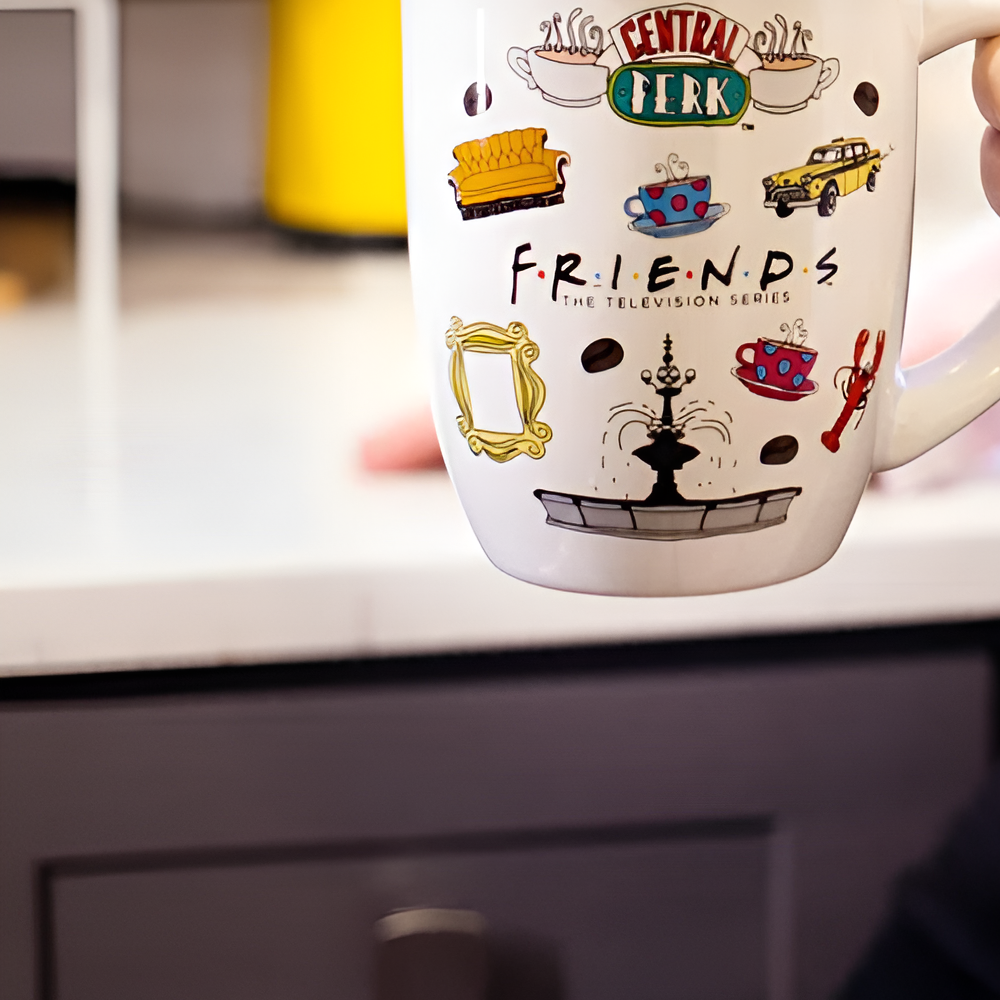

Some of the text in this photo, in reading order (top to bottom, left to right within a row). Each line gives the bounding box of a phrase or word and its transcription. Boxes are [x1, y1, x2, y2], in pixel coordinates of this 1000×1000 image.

[619, 9, 740, 62] CENTRAL
[631, 70, 731, 116] PERK
[562, 291, 790, 309] THE TELEVISION SERIES
